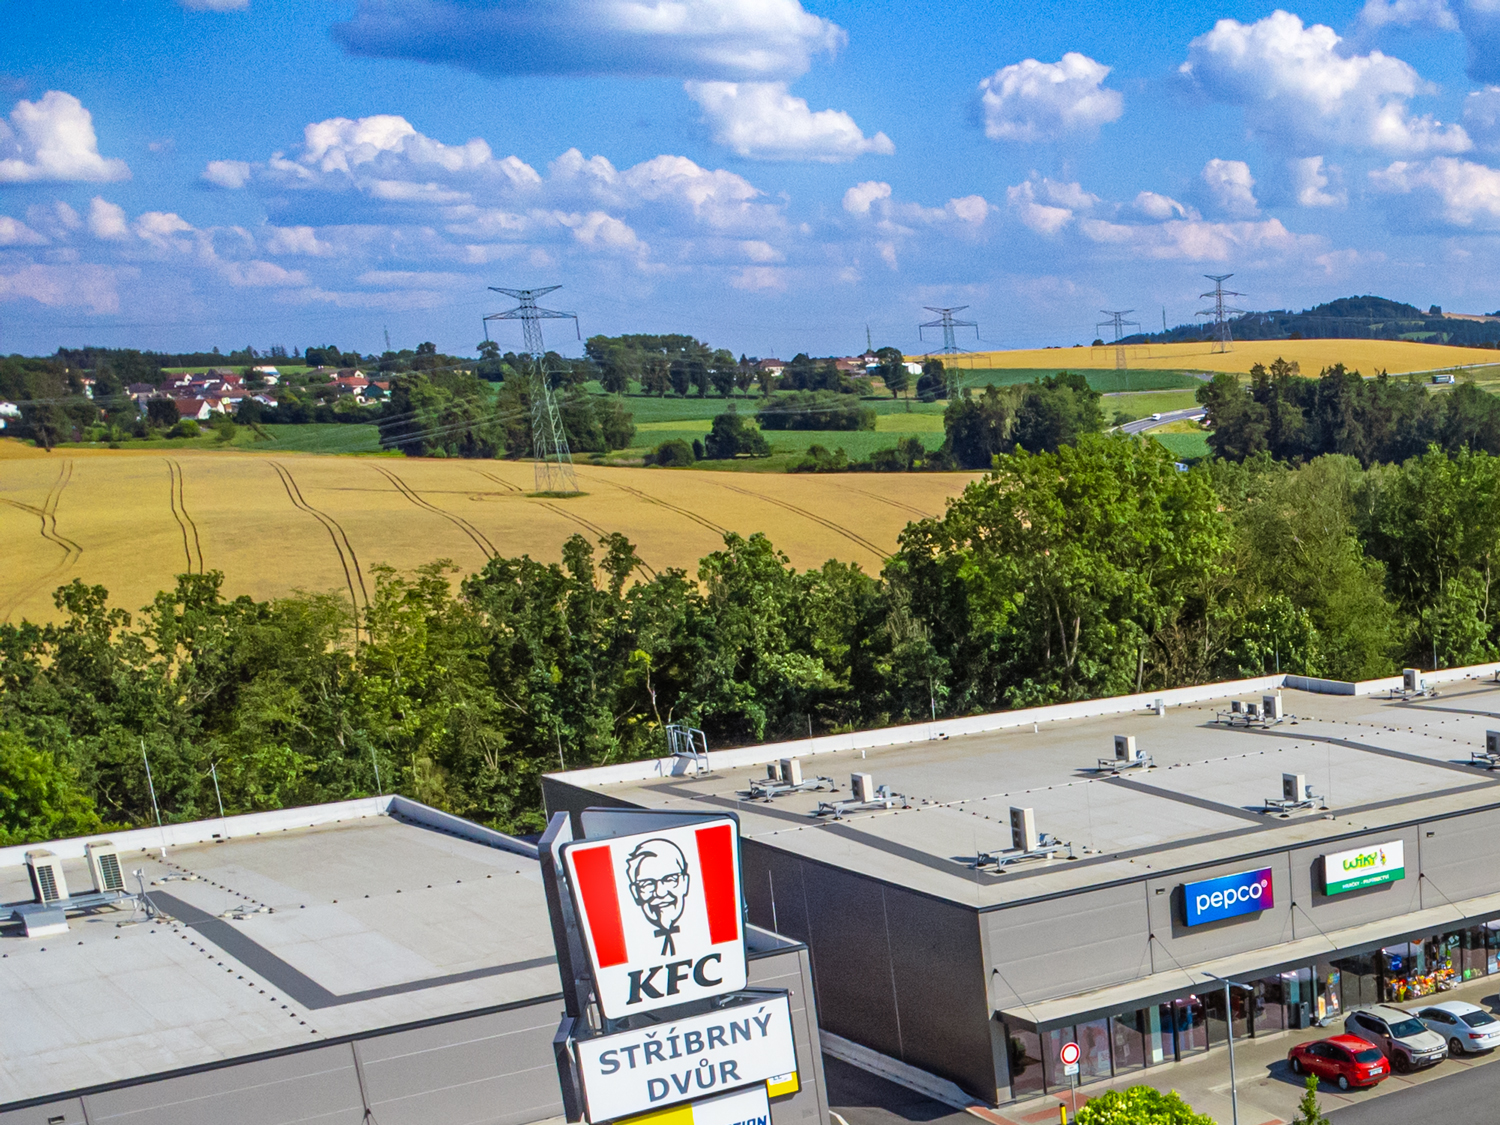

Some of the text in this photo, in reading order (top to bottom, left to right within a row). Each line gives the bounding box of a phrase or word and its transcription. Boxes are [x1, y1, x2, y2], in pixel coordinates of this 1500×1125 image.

[1196, 883, 1263, 915] pepco
[626, 953, 723, 1005] KFC
[599, 1006, 773, 1075] STŘÍBRNÝ
[646, 1058, 742, 1102] DVŮR
